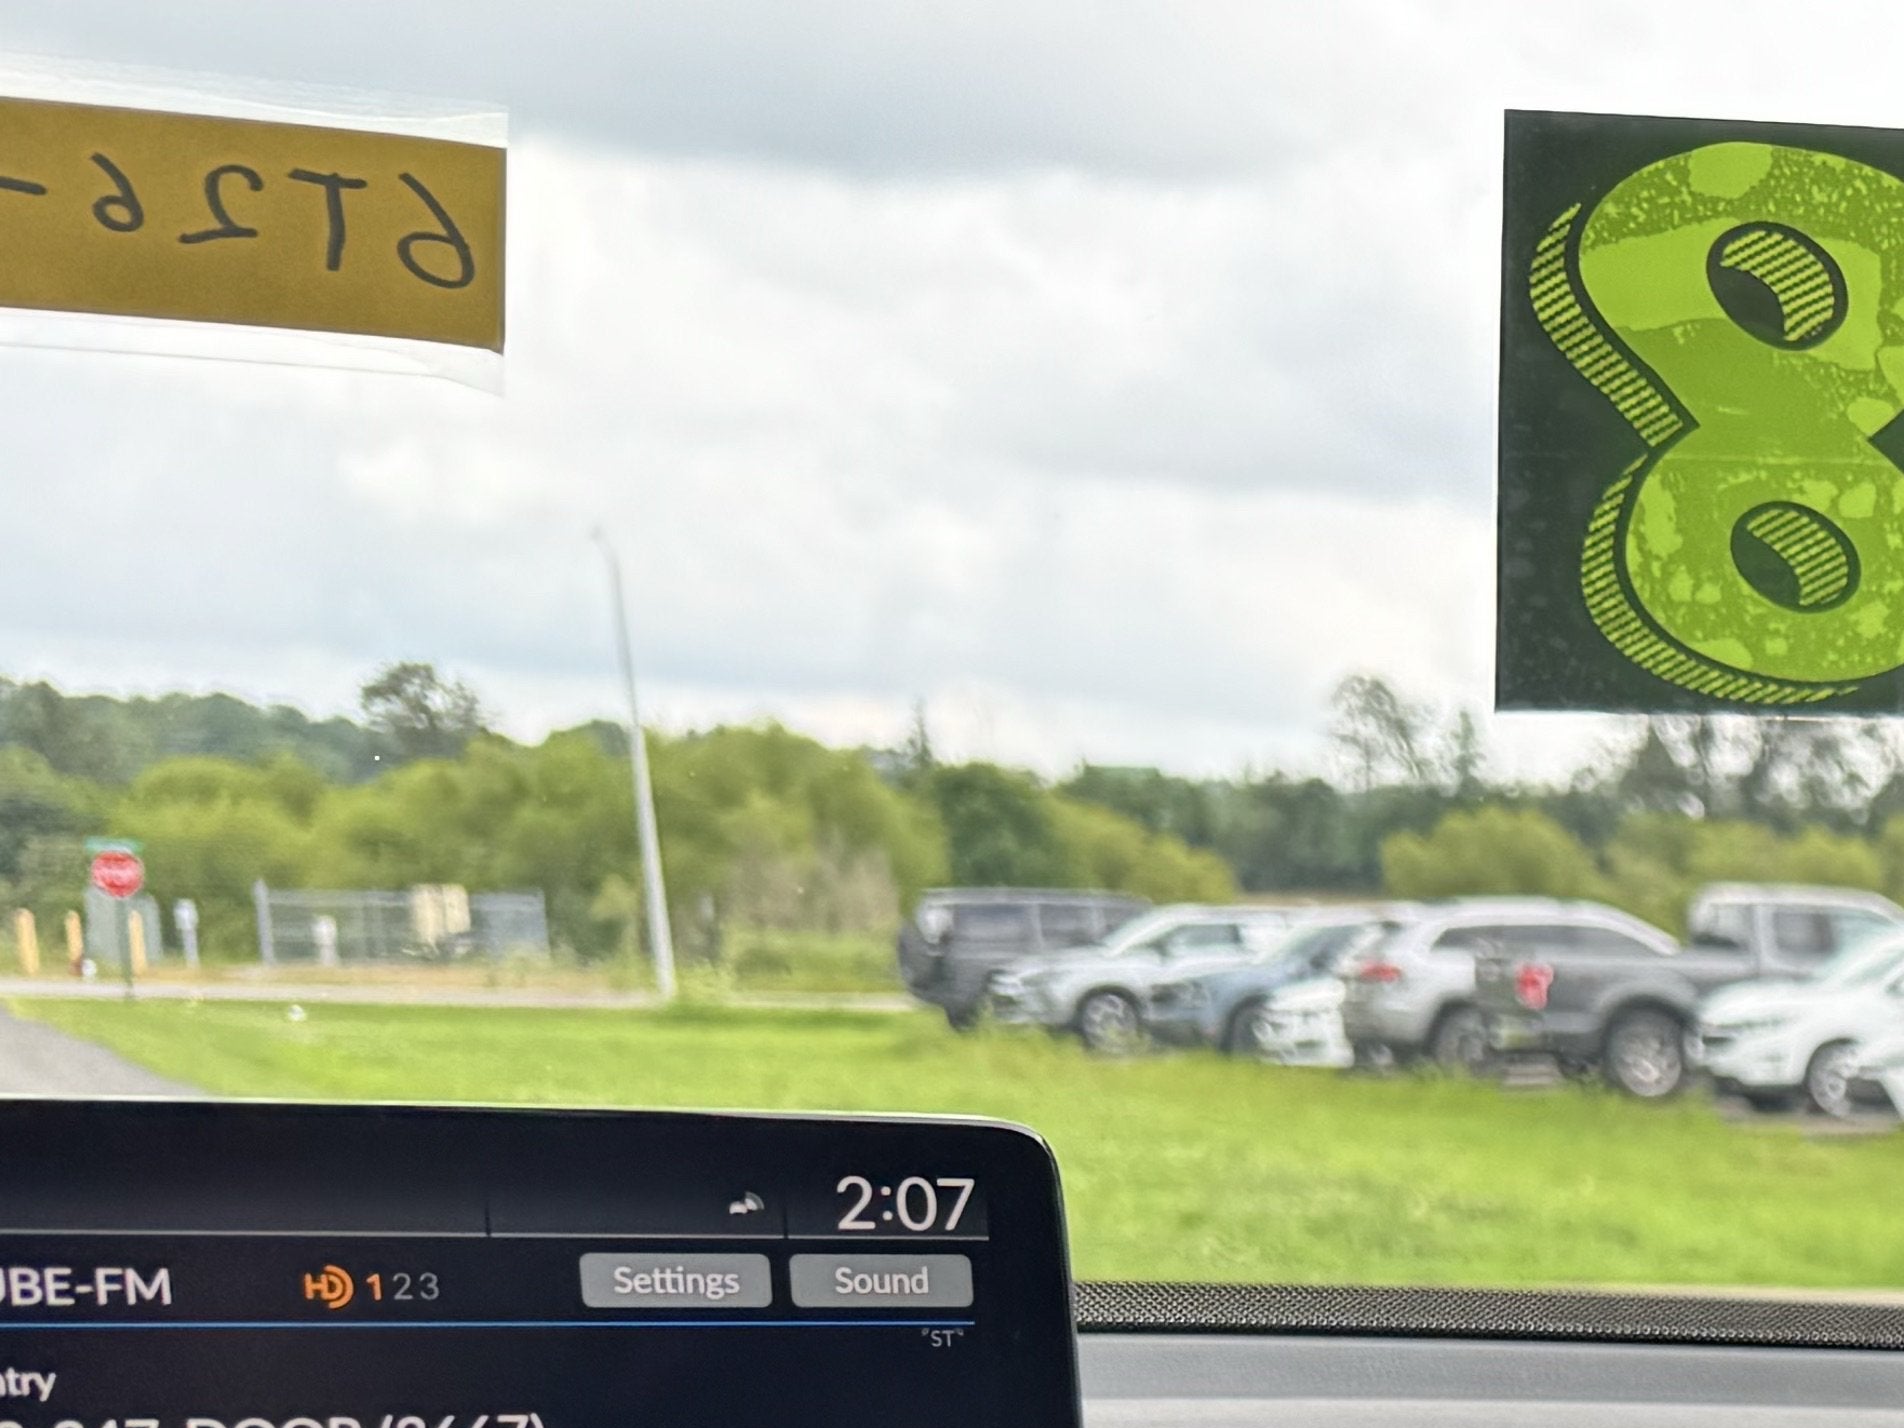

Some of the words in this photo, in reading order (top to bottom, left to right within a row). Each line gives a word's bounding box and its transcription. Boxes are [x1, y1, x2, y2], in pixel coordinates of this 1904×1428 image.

[836, 1175, 975, 1232] 2:07
[366, 1273, 382, 1301] 1
[613, 1265, 740, 1298] Settings
[834, 1265, 930, 1295] Sound
